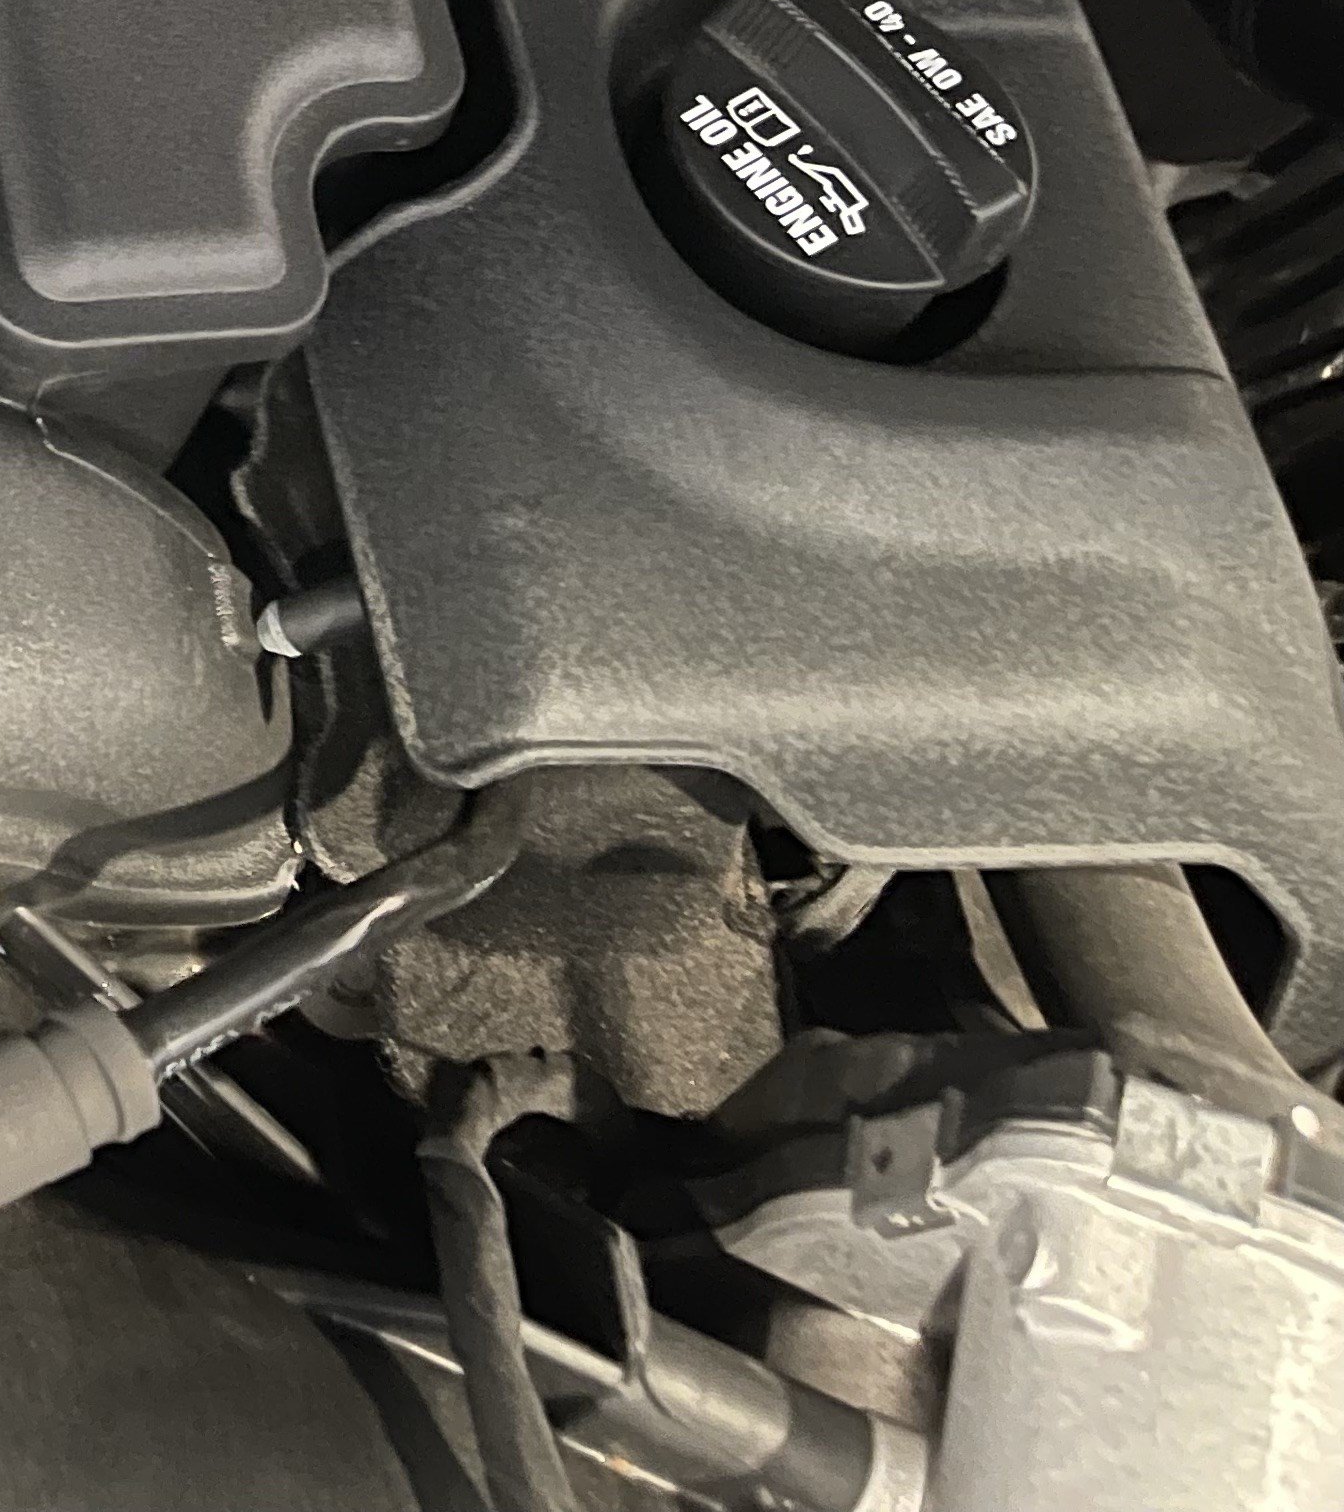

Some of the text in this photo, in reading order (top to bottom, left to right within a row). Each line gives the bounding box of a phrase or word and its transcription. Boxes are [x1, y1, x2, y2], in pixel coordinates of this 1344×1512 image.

[863, 0, 906, 33] 40
[907, 48, 963, 91] 0W
[955, 93, 1018, 146] SAE
[679, 94, 839, 257] ENGINE OIL
